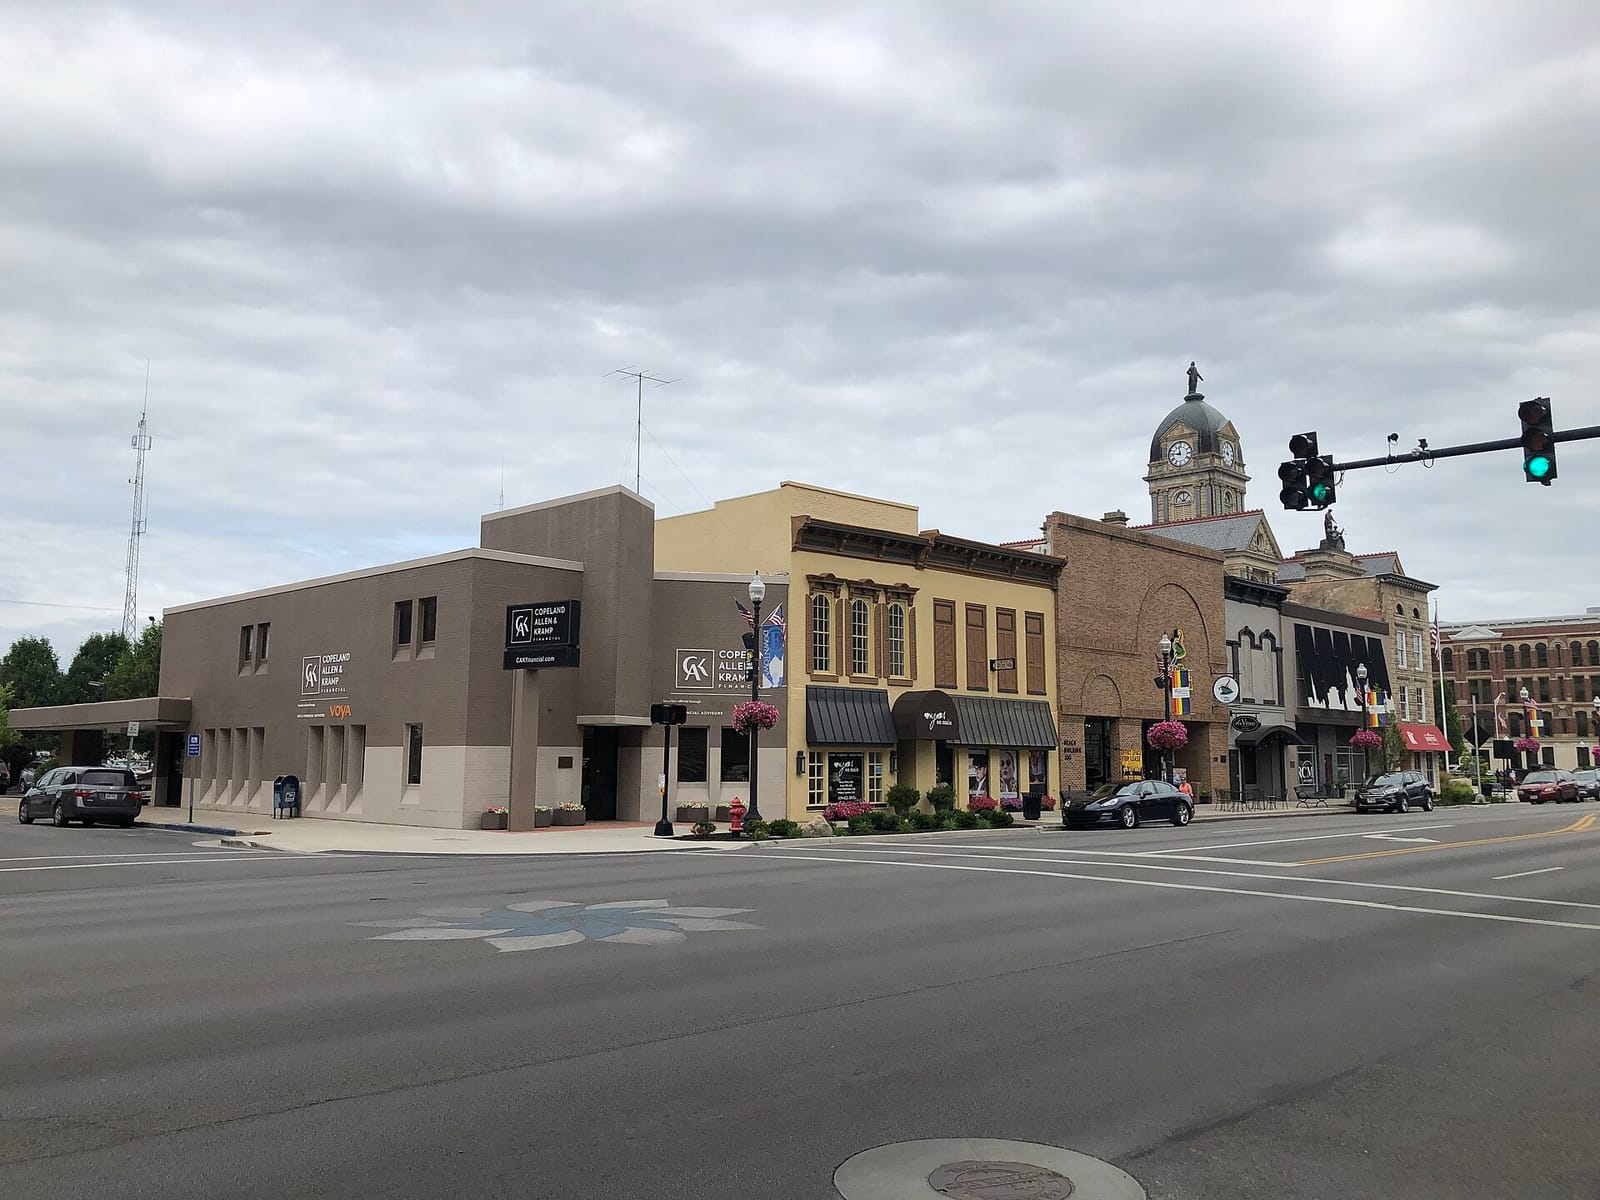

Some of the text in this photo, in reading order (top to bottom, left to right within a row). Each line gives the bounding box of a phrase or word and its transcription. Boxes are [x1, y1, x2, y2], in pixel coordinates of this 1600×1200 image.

[534, 606, 566, 616] COPELAND
[534, 618, 552, 626] ALLEN
[534, 627, 554, 635] KRAMP
[322, 652, 351, 664] COPELAND
[321, 665, 339, 675] ALLEN
[321, 676, 339, 686] KRAMP
[719, 673, 746, 682] KRAM
